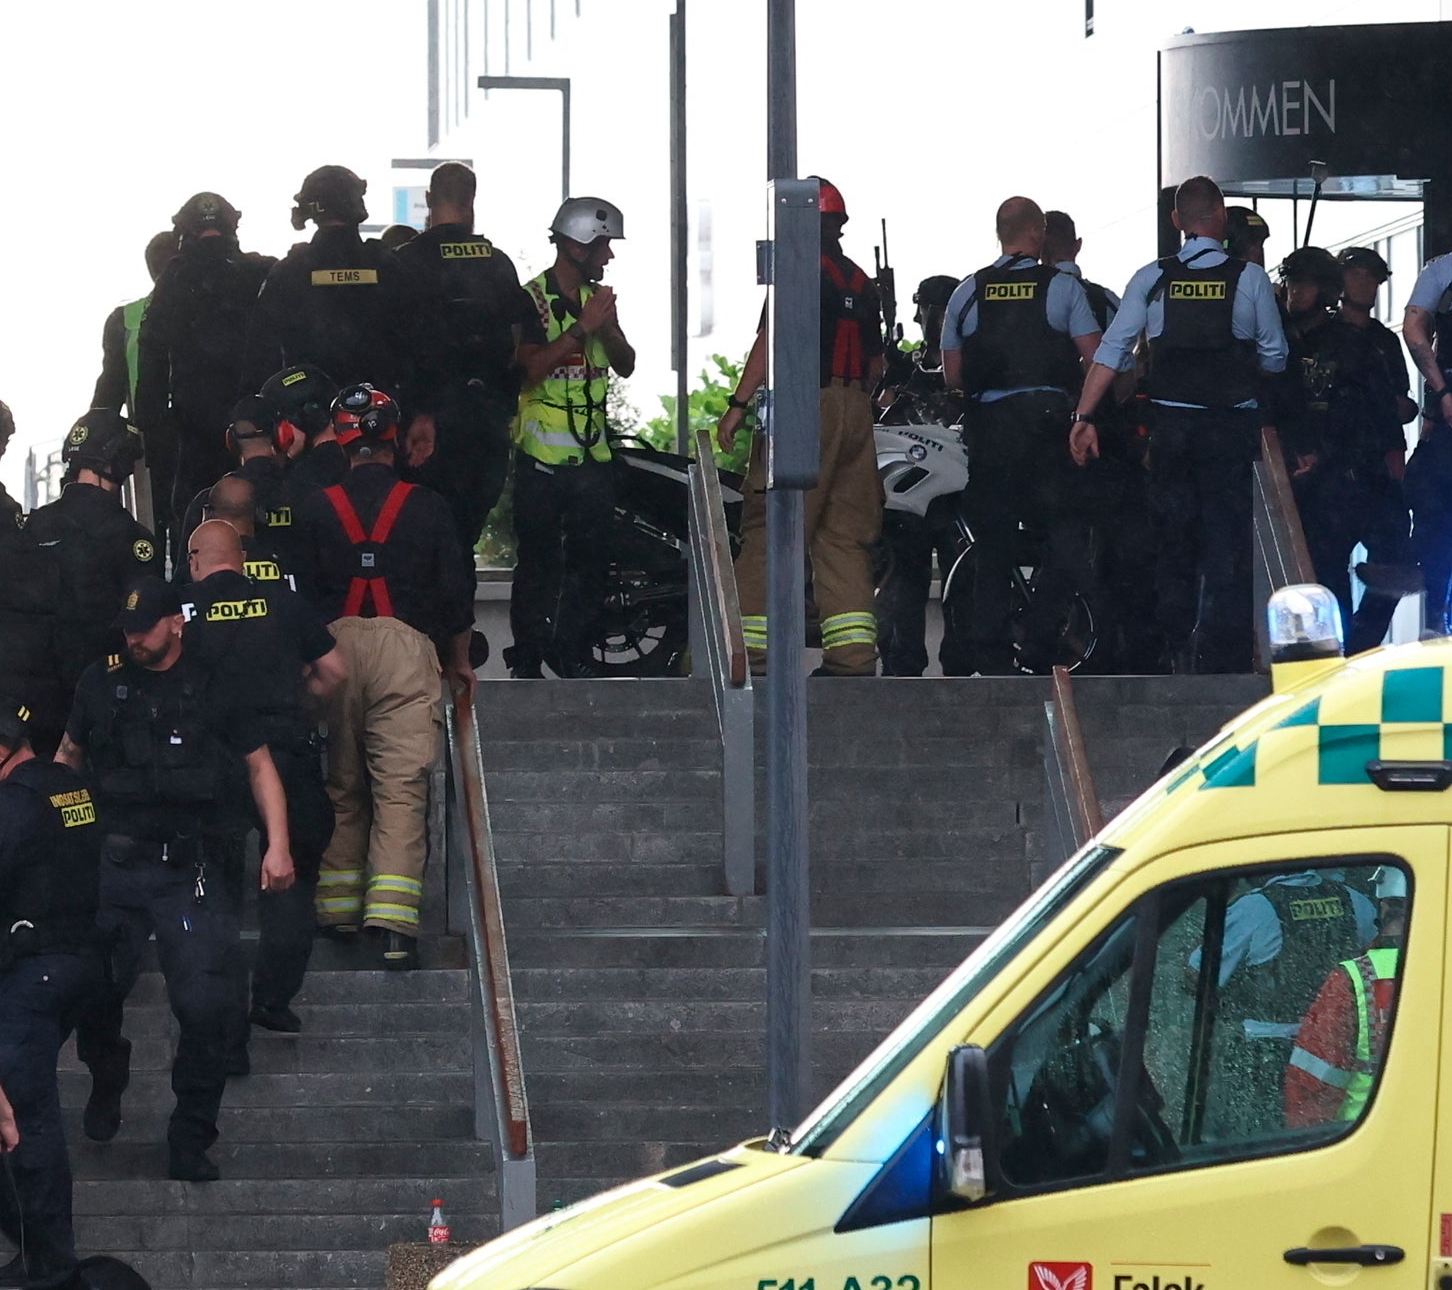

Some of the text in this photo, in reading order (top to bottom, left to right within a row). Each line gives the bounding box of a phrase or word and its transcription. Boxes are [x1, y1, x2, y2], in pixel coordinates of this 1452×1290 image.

[442, 245, 490, 257] POLITI
[330, 272, 360, 282] TEMS
[986, 285, 1036, 298] POLITI
[1171, 284, 1225, 297] POLITI
[898, 430, 944, 452] POLITI
[247, 564, 278, 577] LITI
[207, 600, 267, 619] POLITI
[63, 805, 95, 825] POLITI
